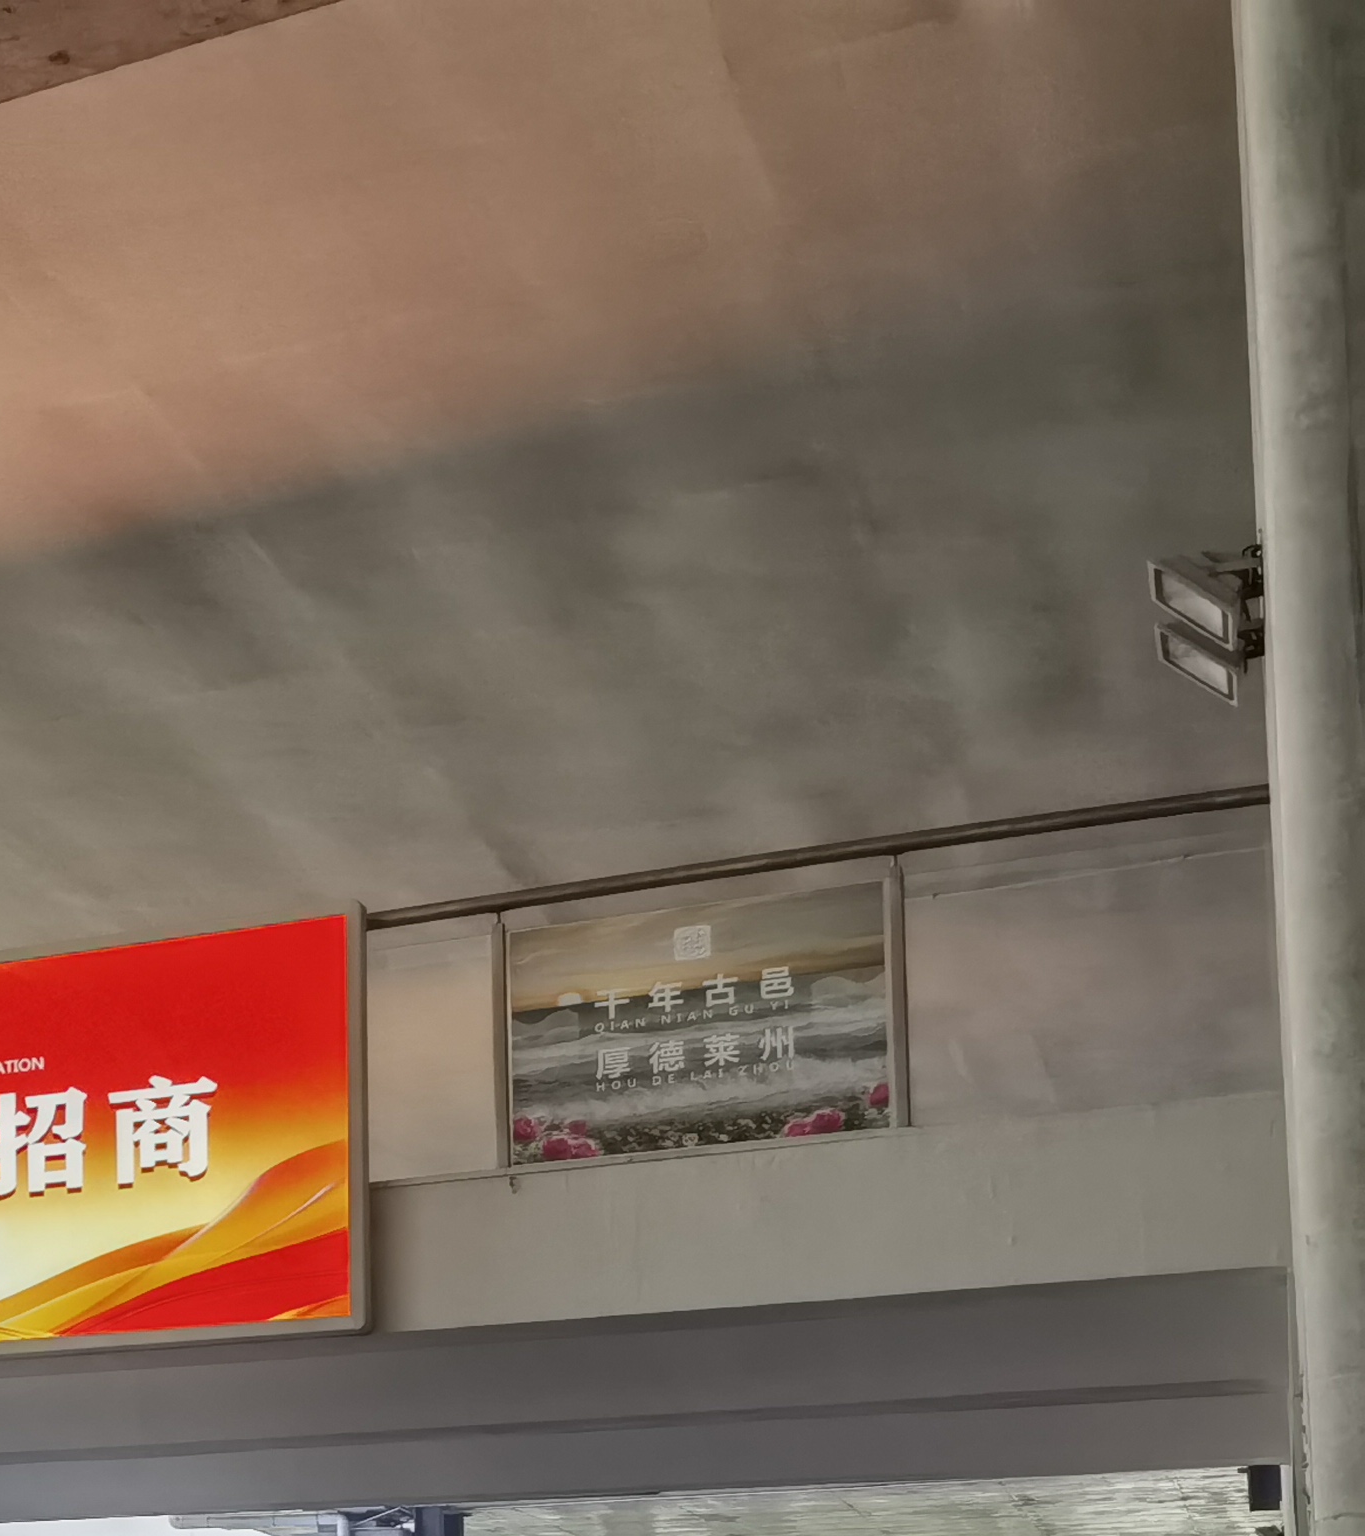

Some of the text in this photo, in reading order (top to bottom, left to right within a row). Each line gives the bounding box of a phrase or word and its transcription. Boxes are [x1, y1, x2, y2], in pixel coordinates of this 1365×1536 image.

[594, 966, 795, 1020] 千年古邑
[595, 1018, 646, 1033] QIAN
[661, 1009, 713, 1025] NIAN
[729, 1004, 754, 1017] GU
[595, 1026, 795, 1080] 厚德莱州
[596, 1061, 795, 1092] HOU DE LAI ZHOU
